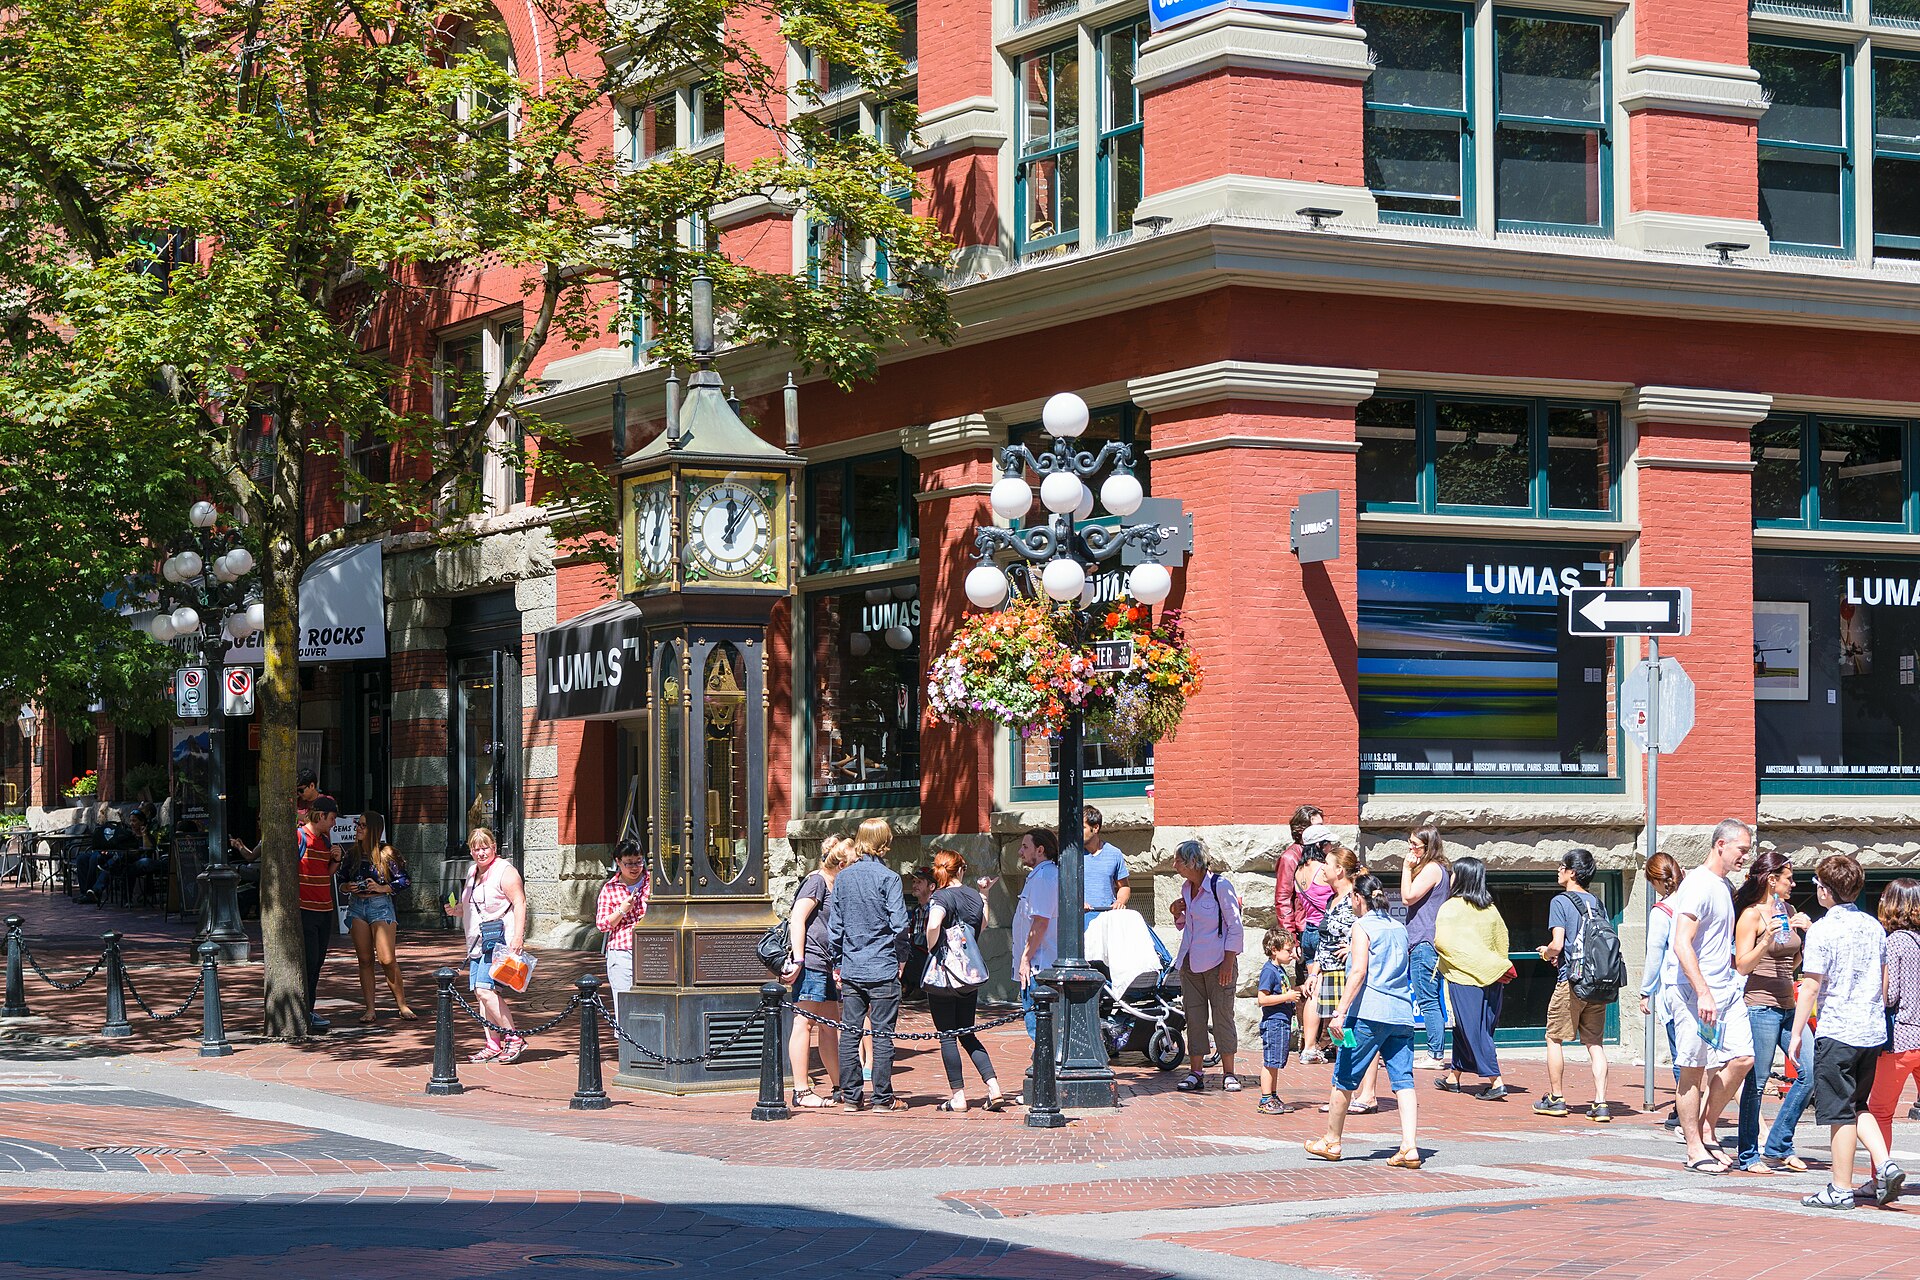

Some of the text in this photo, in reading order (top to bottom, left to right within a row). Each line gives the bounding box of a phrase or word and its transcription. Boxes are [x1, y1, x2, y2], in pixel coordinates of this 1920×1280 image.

[1300, 521, 1327, 535] LUMAS
[1466, 563, 1580, 597] LUMAS
[862, 599, 921, 632] LUMAS
[307, 626, 366, 647] ROCKS
[1120, 645, 1127, 656] ST
[547, 647, 622, 695] LUMAS
[1360, 753, 1397, 762] LUMAS.COM
[1360, 762, 1392, 772] AMSTERDAM
[1394, 762, 1412, 772] BERLIN
[1433, 762, 1452, 772] LONDON
[1455, 762, 1472, 772] MILAN
[1474, 762, 1497, 772] MOSCOW
[1499, 762, 1510, 772] NEW
[1765, 765, 1795, 774] AMSTERDAM
[333, 825, 352, 833] GEMS
